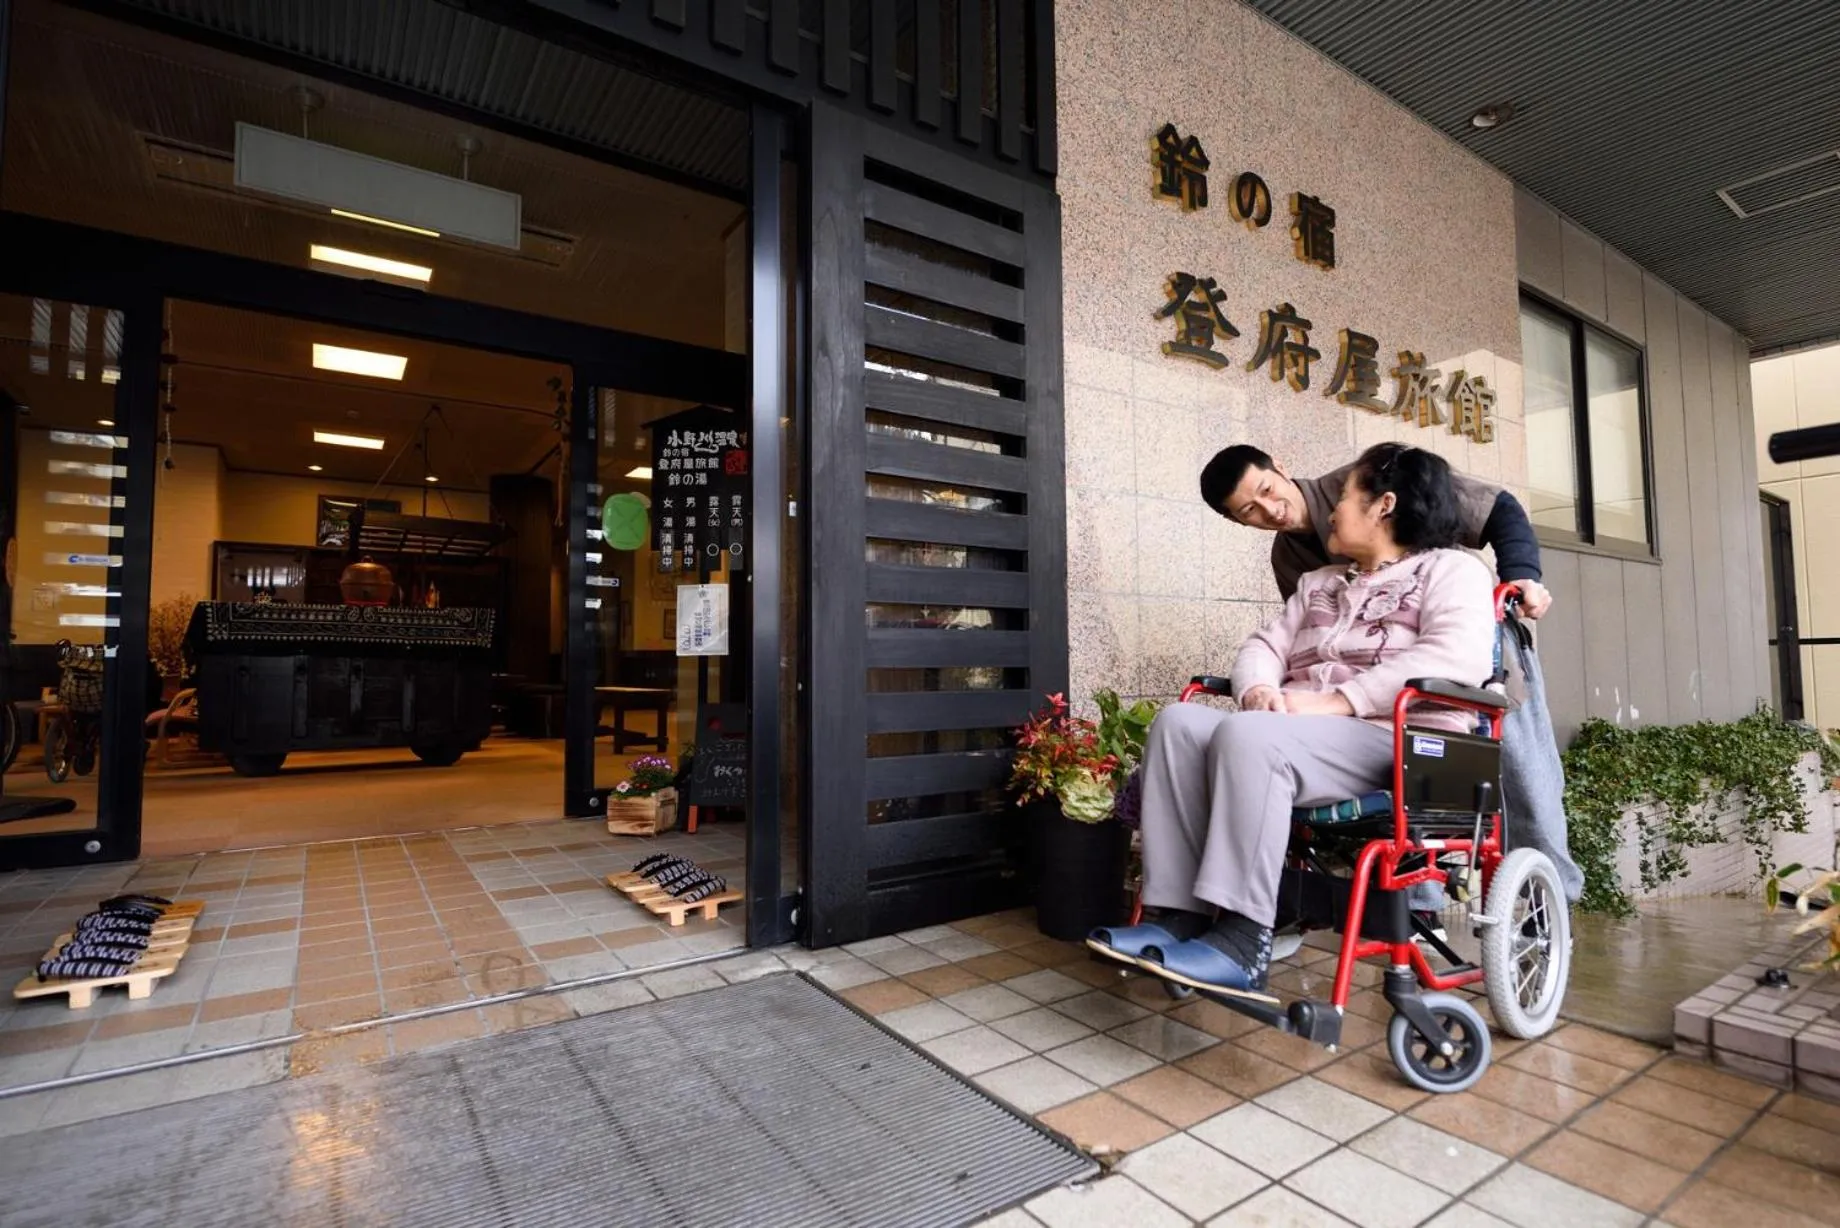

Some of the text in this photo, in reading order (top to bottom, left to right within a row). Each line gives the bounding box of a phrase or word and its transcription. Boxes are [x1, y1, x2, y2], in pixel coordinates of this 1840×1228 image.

[1150, 122, 1337, 271] 鈴の宿
[1154, 270, 1497, 444] 登府屋旅館
[658, 457, 720, 470] 登府屋旅館
[668, 472, 708, 486] 鈴の湯
